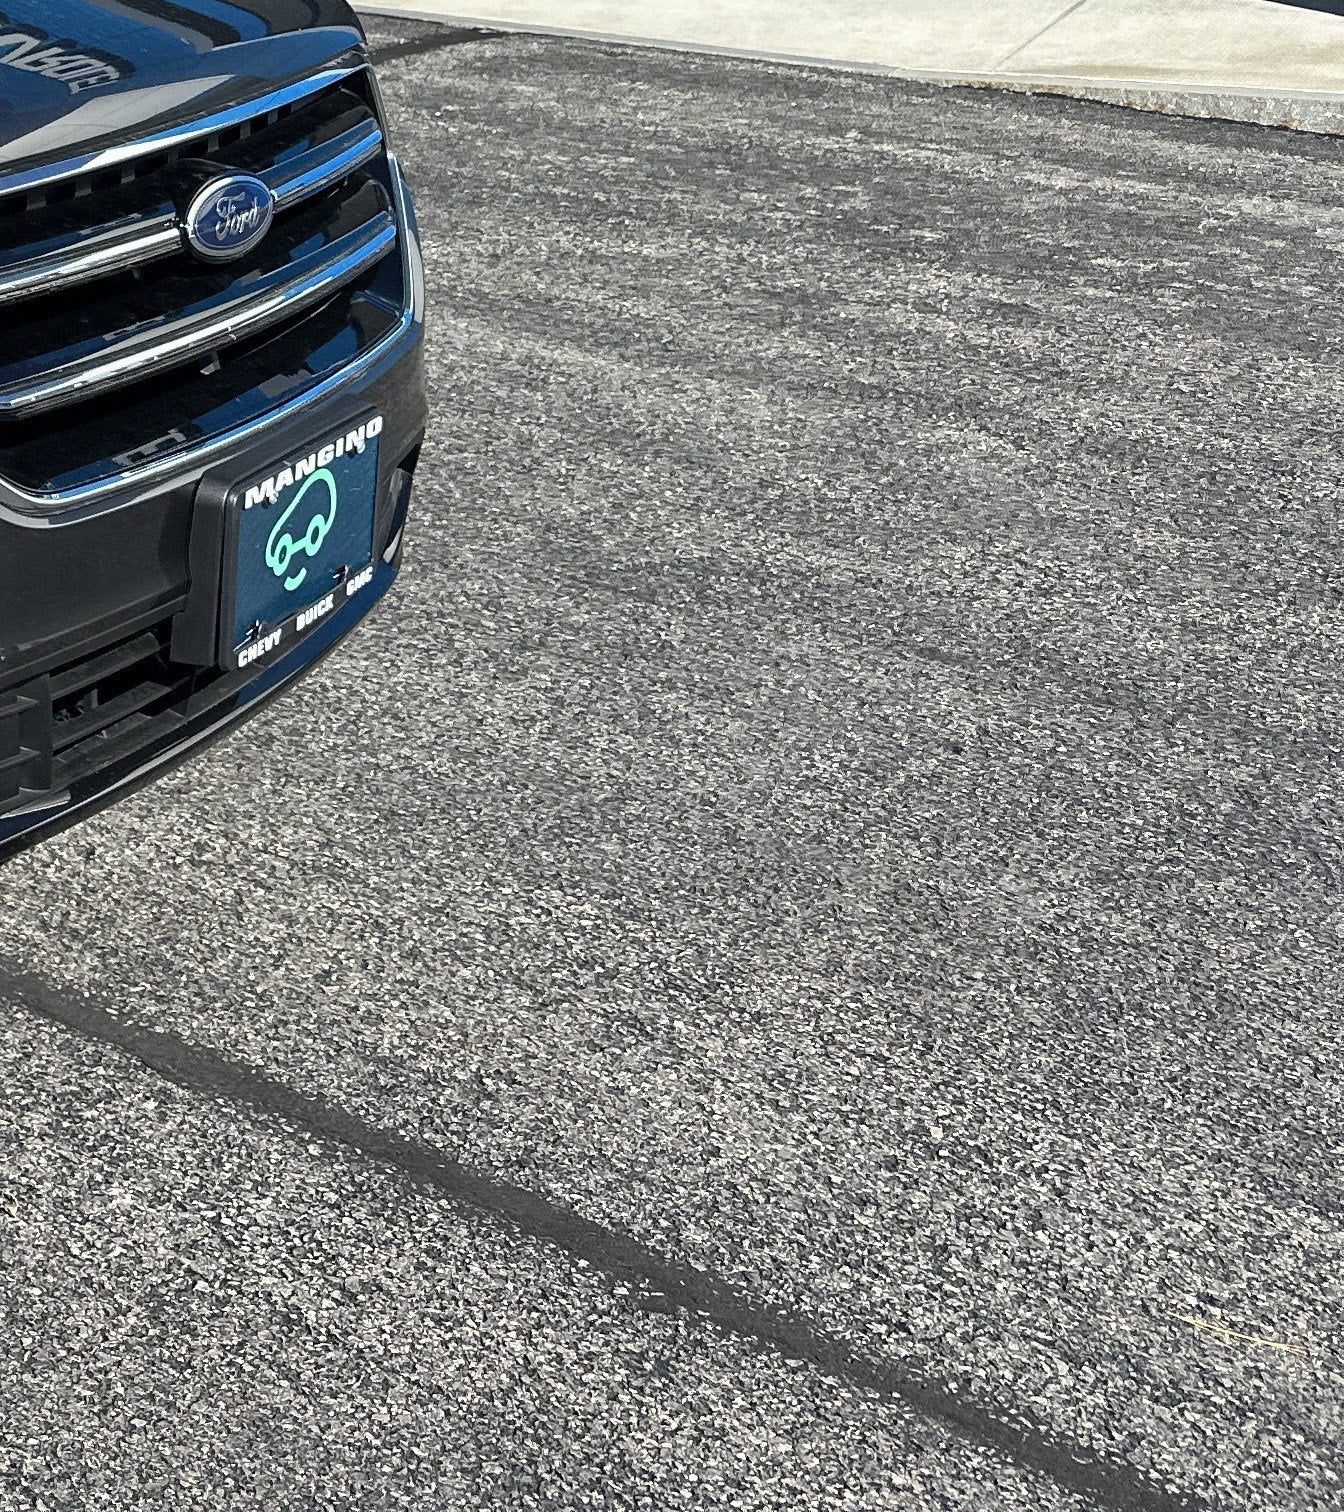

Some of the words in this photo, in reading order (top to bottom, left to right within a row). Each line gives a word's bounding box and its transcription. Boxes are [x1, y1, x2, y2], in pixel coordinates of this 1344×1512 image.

[215, 191, 261, 241] Ford
[244, 416, 383, 510] MANGINO
[237, 628, 283, 668] CHEVY
[295, 593, 335, 632] BUICK
[345, 565, 374, 597] GMC
